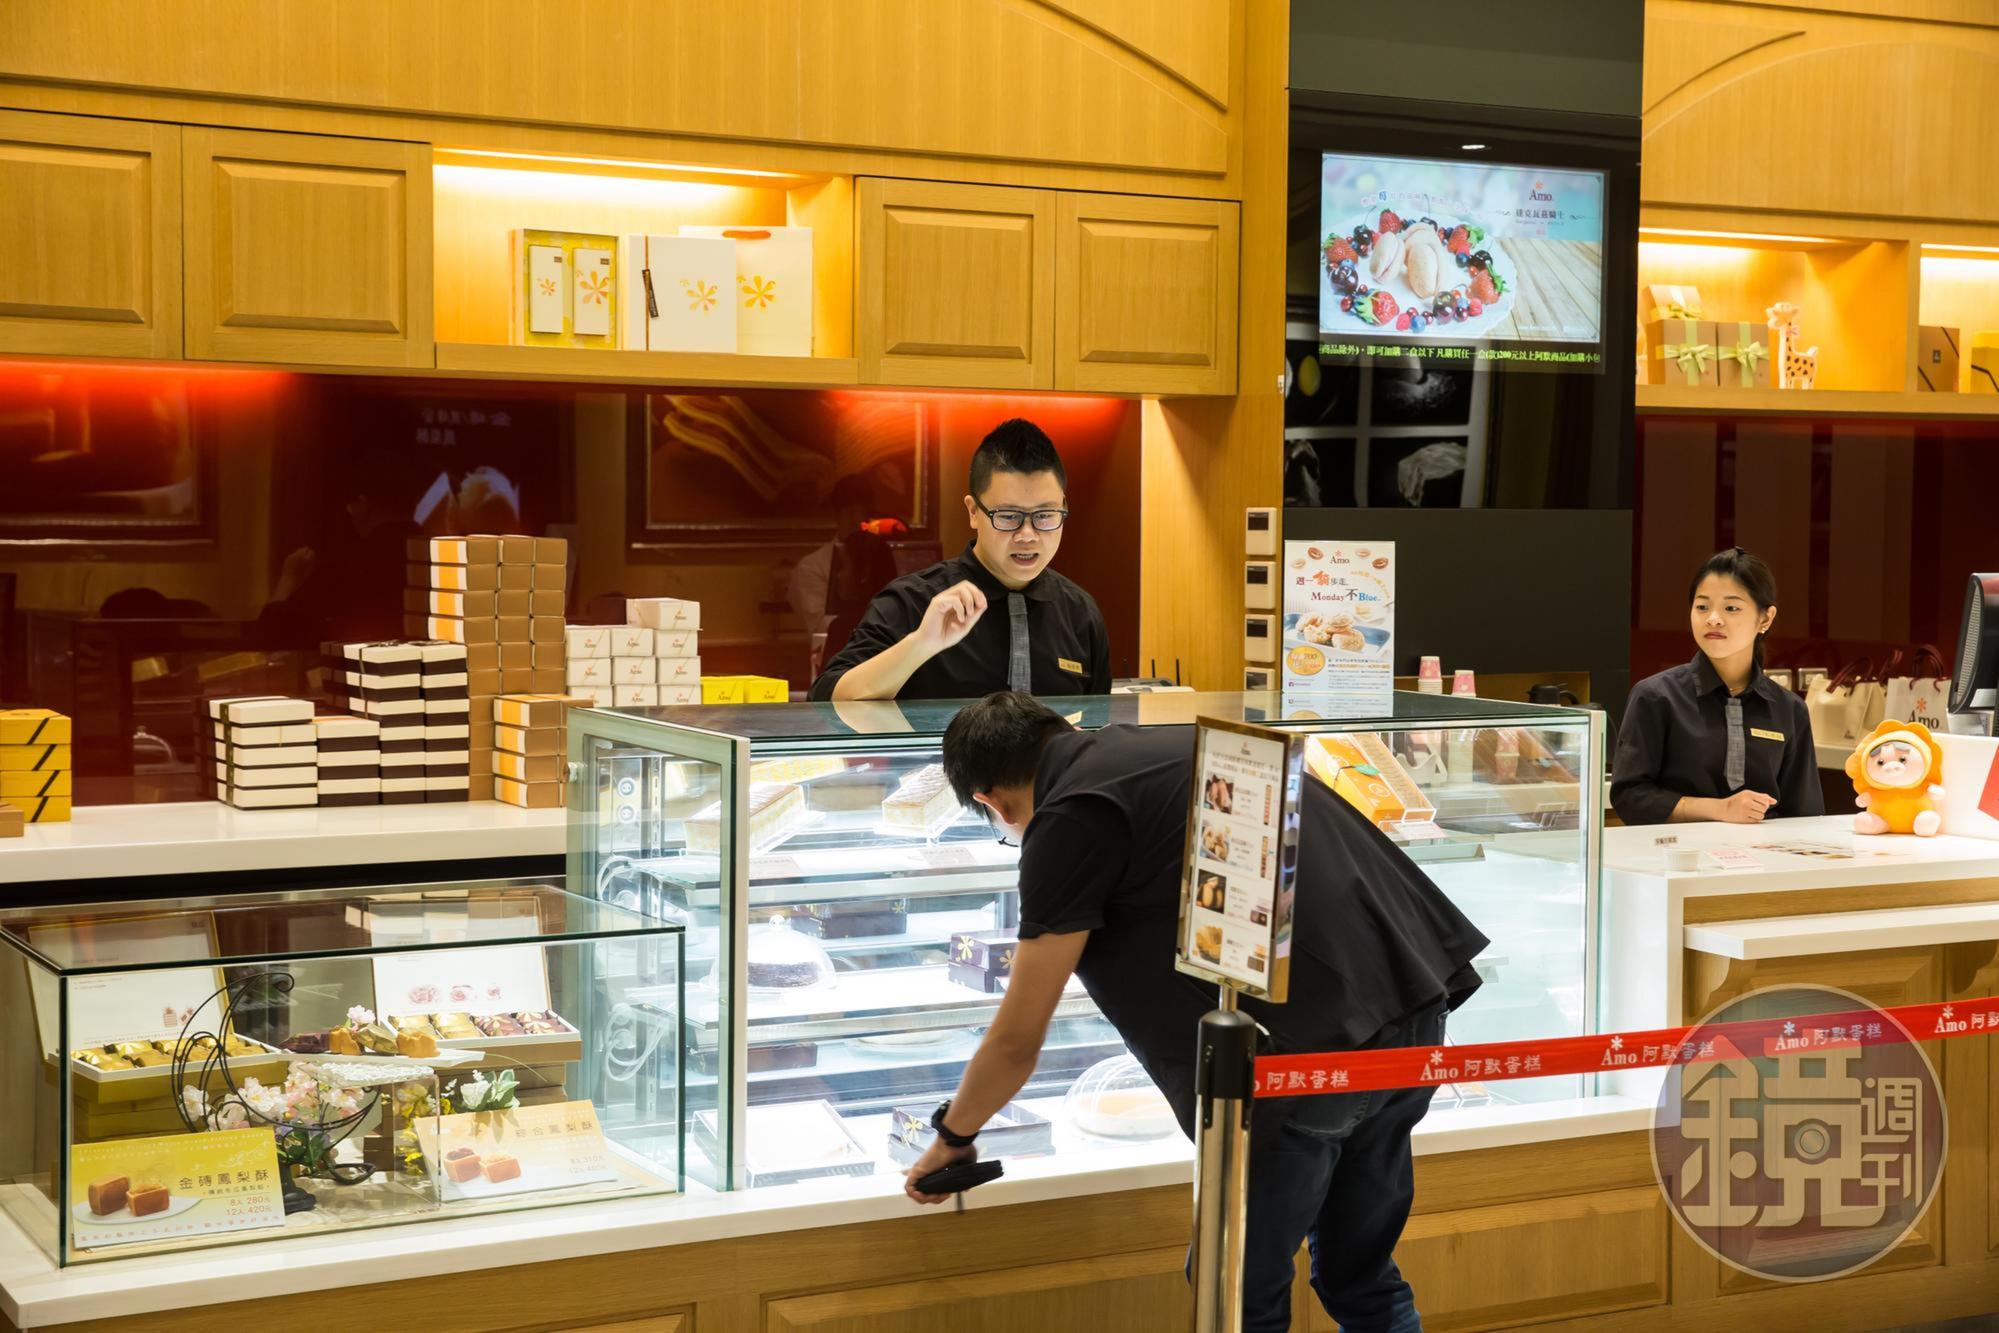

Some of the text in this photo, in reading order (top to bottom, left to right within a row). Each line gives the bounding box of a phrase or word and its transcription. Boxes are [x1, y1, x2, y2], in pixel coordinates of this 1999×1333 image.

[1529, 189, 1553, 201] Amo
[1330, 556, 1350, 564] Amo
[1908, 710, 1940, 729] Amo
[1934, 1016, 1967, 1033] Amo
[1775, 1022, 1883, 1051] Amo 阿默蛋糕
[1601, 1040, 1715, 1065] Amo 阿默蛋糕
[1420, 1055, 1541, 1081] Amo 阿默蛋糕
[1266, 1070, 1350, 1090] 阿默蛋糕
[179, 1169, 270, 1190] 金磚鳳梨酥
